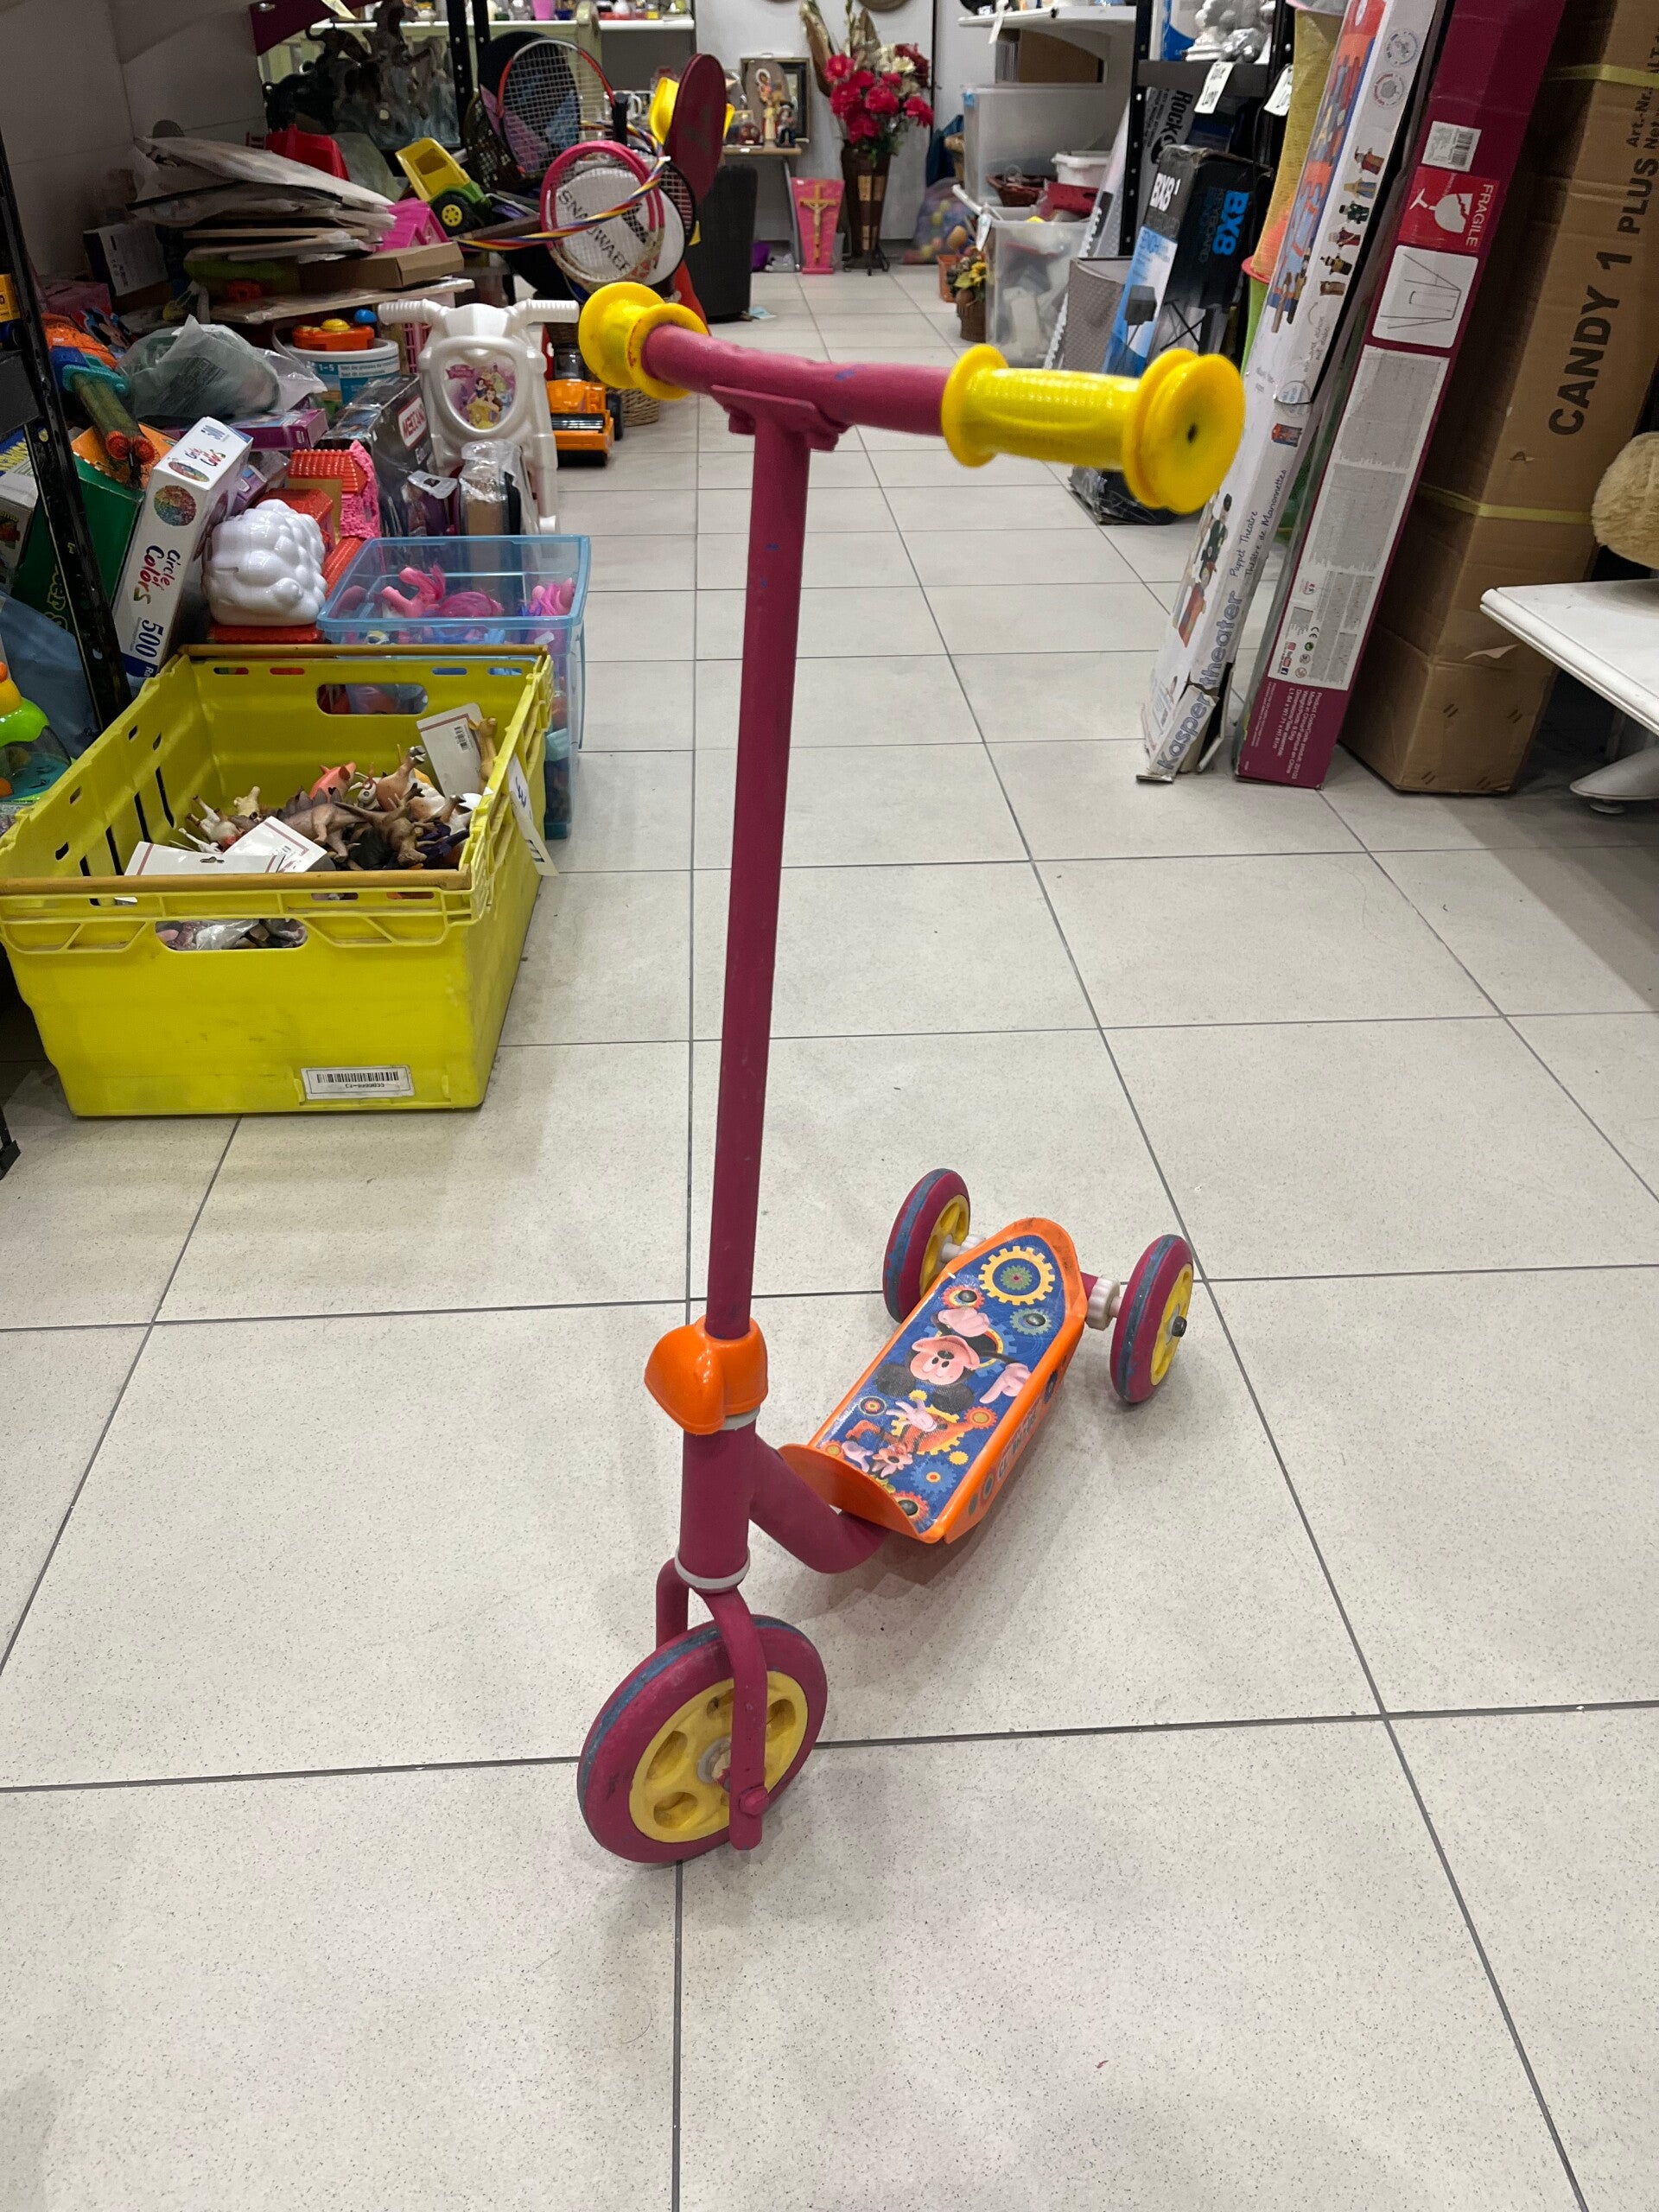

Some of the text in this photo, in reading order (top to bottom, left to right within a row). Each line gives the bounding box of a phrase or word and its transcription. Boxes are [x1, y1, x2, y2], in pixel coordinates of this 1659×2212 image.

[1211, 189, 1250, 256] BX8
[1465, 183, 1495, 247] FRAGILE
[1548, 158, 1659, 435] CANDY 1 PLUS
[162, 548, 181, 588] Circle
[1230, 511, 1258, 577] Puppet Theatre
[1258, 531, 1267, 541] de
[133, 544, 165, 605] Colors
[135, 618, 164, 658] 500
[1156, 691, 1211, 770] Kasper
[1198, 590, 1244, 688] theater
